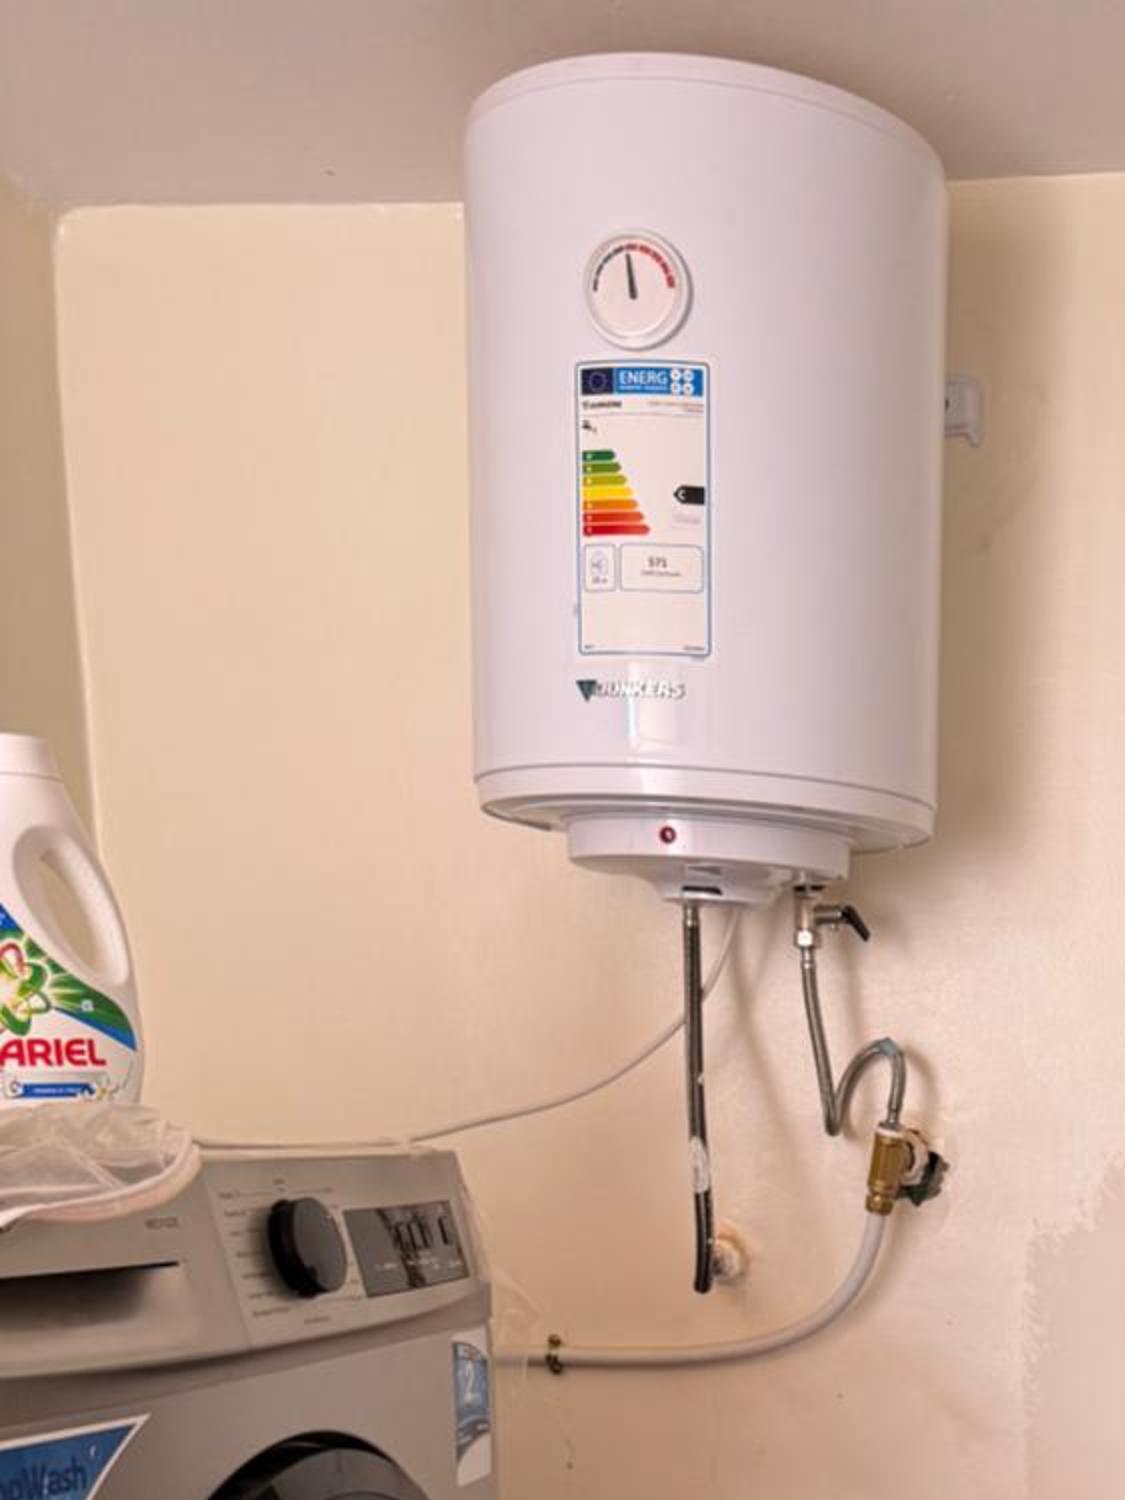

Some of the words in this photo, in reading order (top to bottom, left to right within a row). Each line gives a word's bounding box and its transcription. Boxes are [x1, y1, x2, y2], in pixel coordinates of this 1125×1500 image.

[619, 369, 668, 385] ENERG
[594, 680, 686, 699] JUNKERS
[0, 1038, 107, 1067] ARIEL
